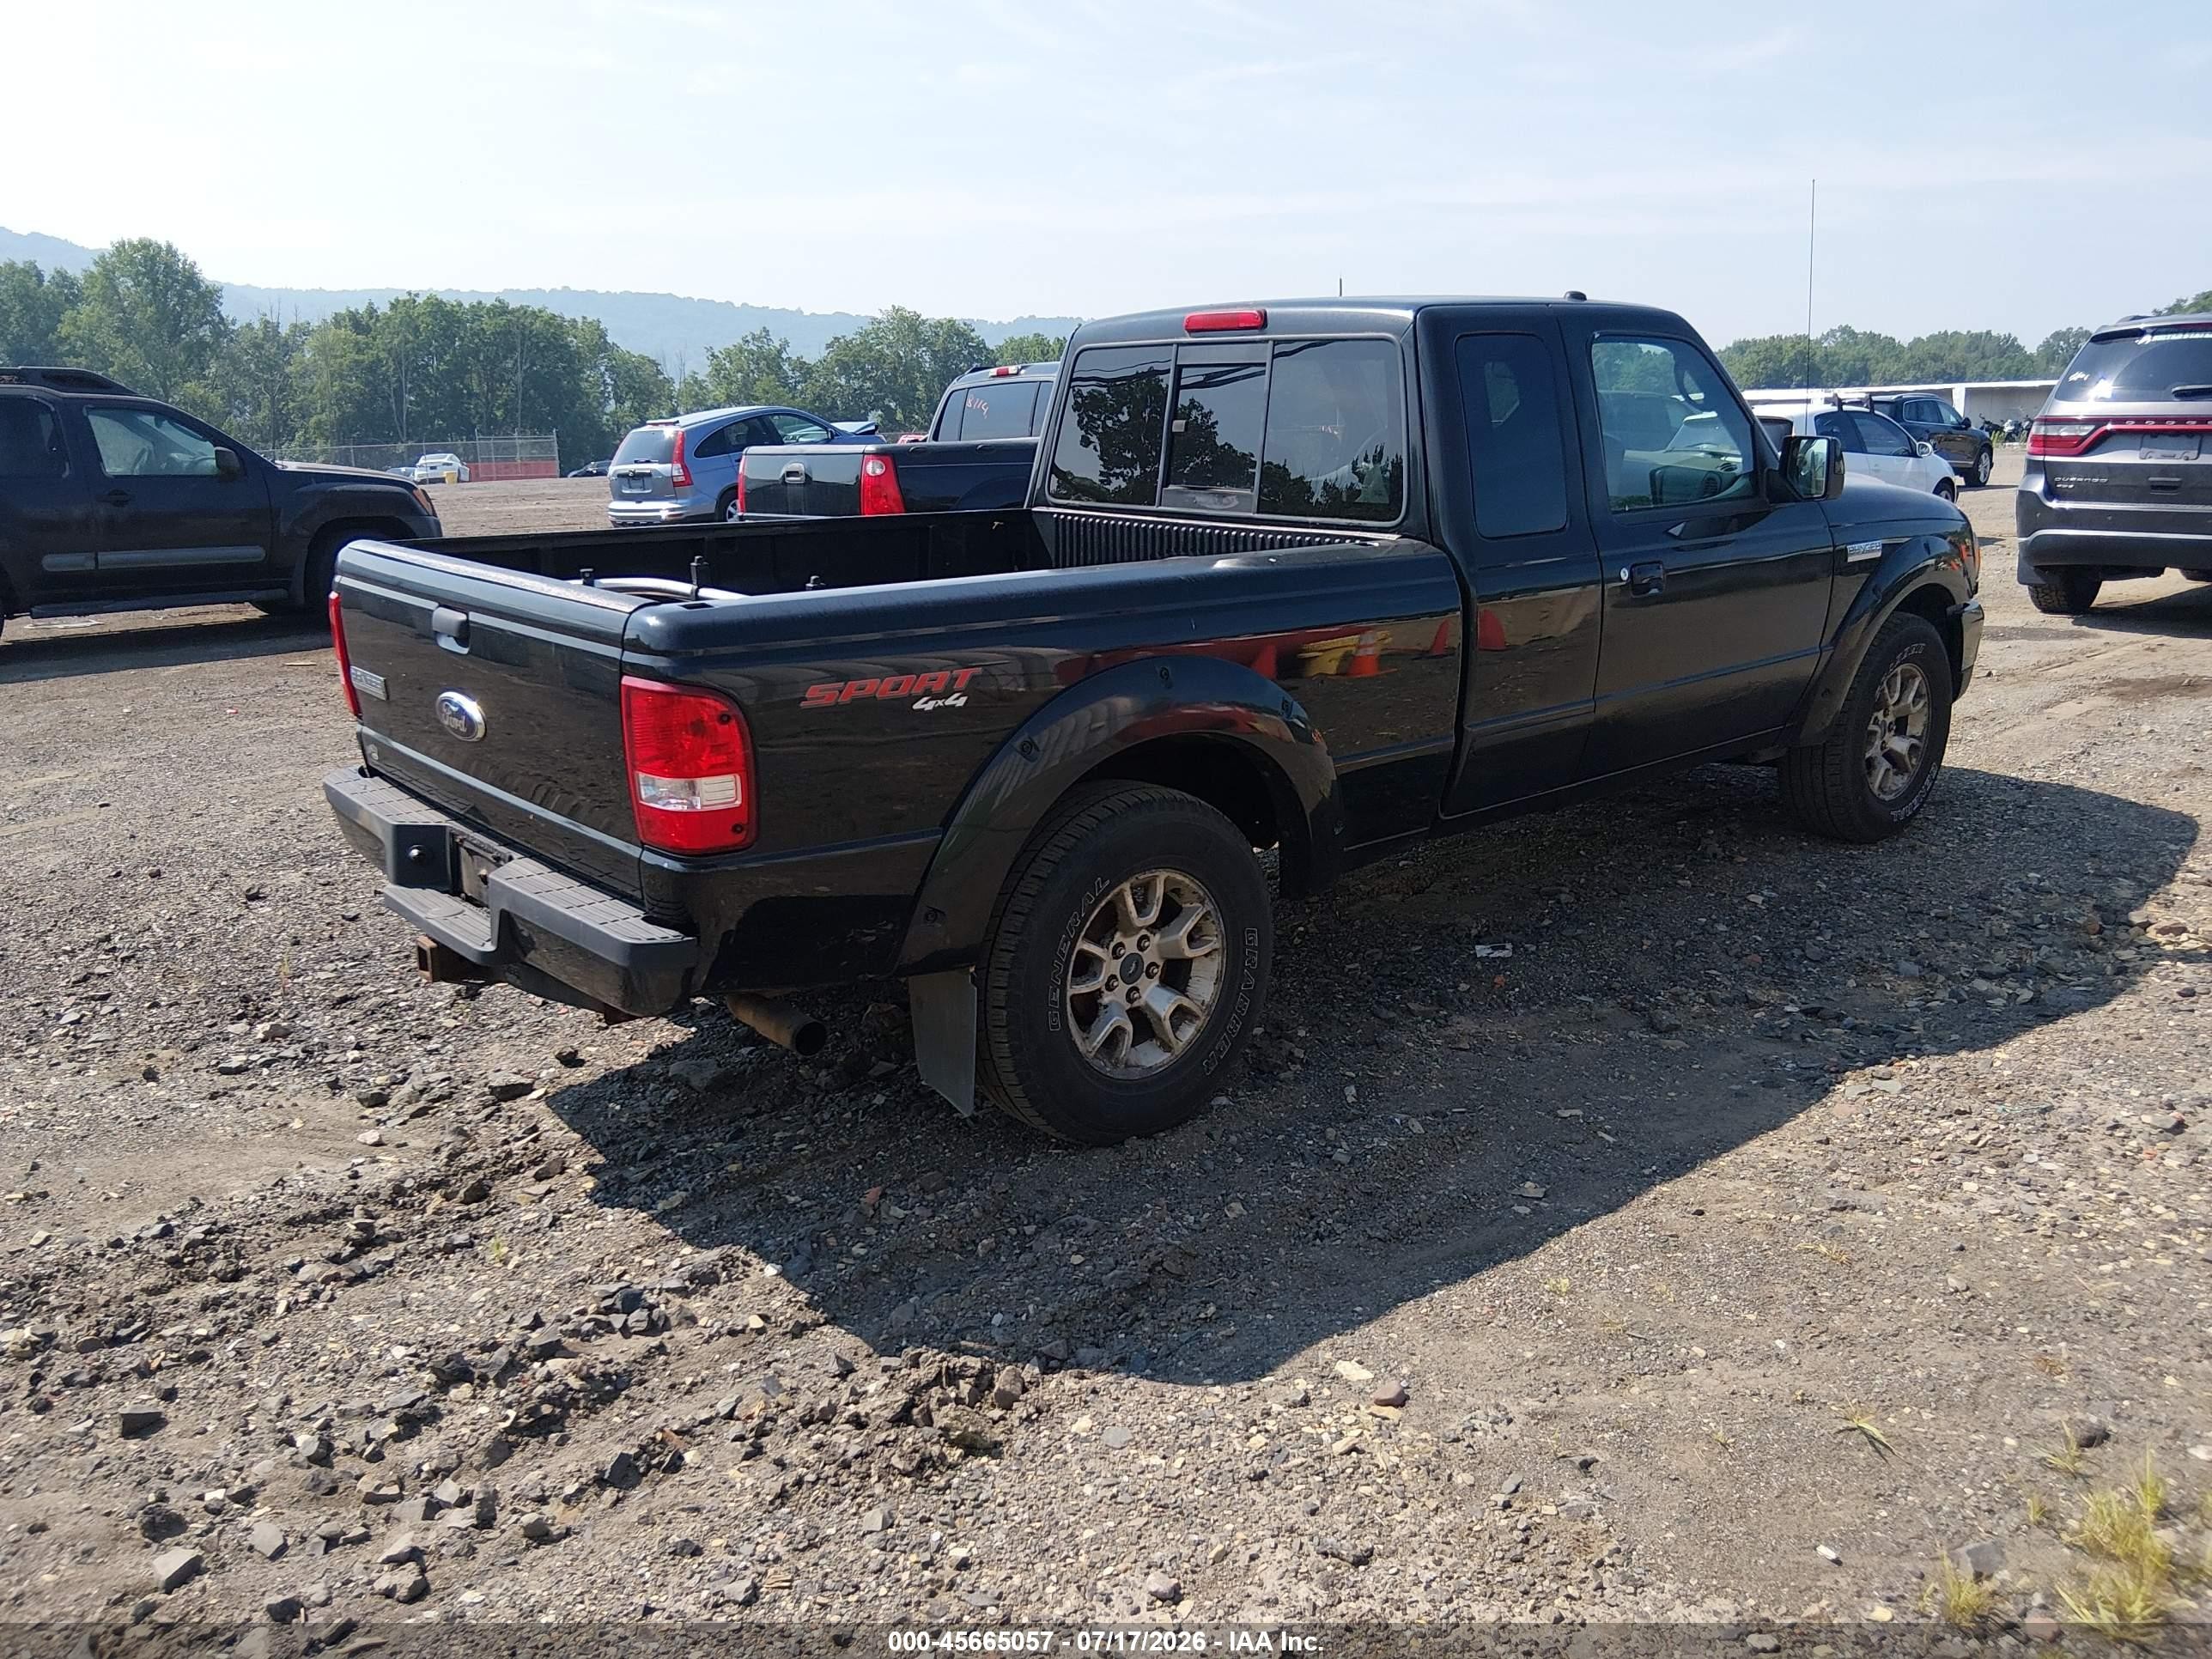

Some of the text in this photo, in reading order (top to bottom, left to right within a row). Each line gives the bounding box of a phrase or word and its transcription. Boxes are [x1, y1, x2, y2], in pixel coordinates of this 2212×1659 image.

[799, 667, 982, 708] SPORT
[912, 692, 969, 711] 4x4
[1048, 876, 1111, 1031] GENERAL
[1202, 927, 1259, 1076] GRABBER
